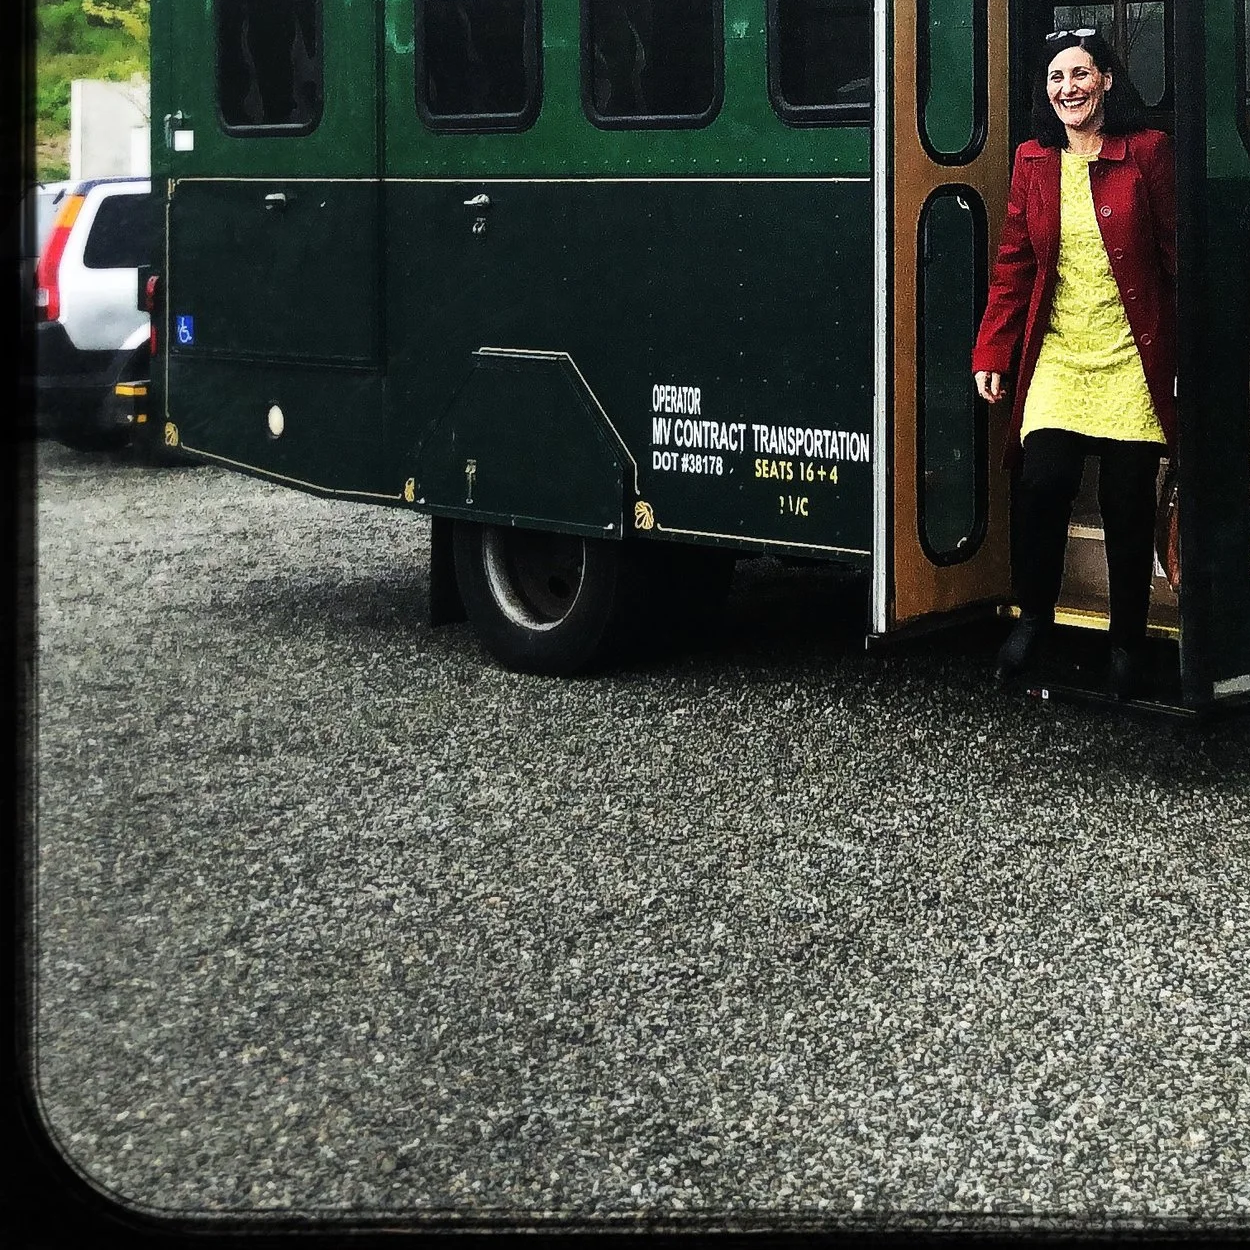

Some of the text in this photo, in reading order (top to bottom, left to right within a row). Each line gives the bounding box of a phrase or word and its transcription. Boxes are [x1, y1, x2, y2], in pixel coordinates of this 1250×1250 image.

[652, 384, 701, 415] OPERATOR
[652, 417, 870, 463] MV CONTRACT TRANSPORTATION
[652, 451, 723, 476] DOT #38178
[755, 458, 794, 481] SEATS
